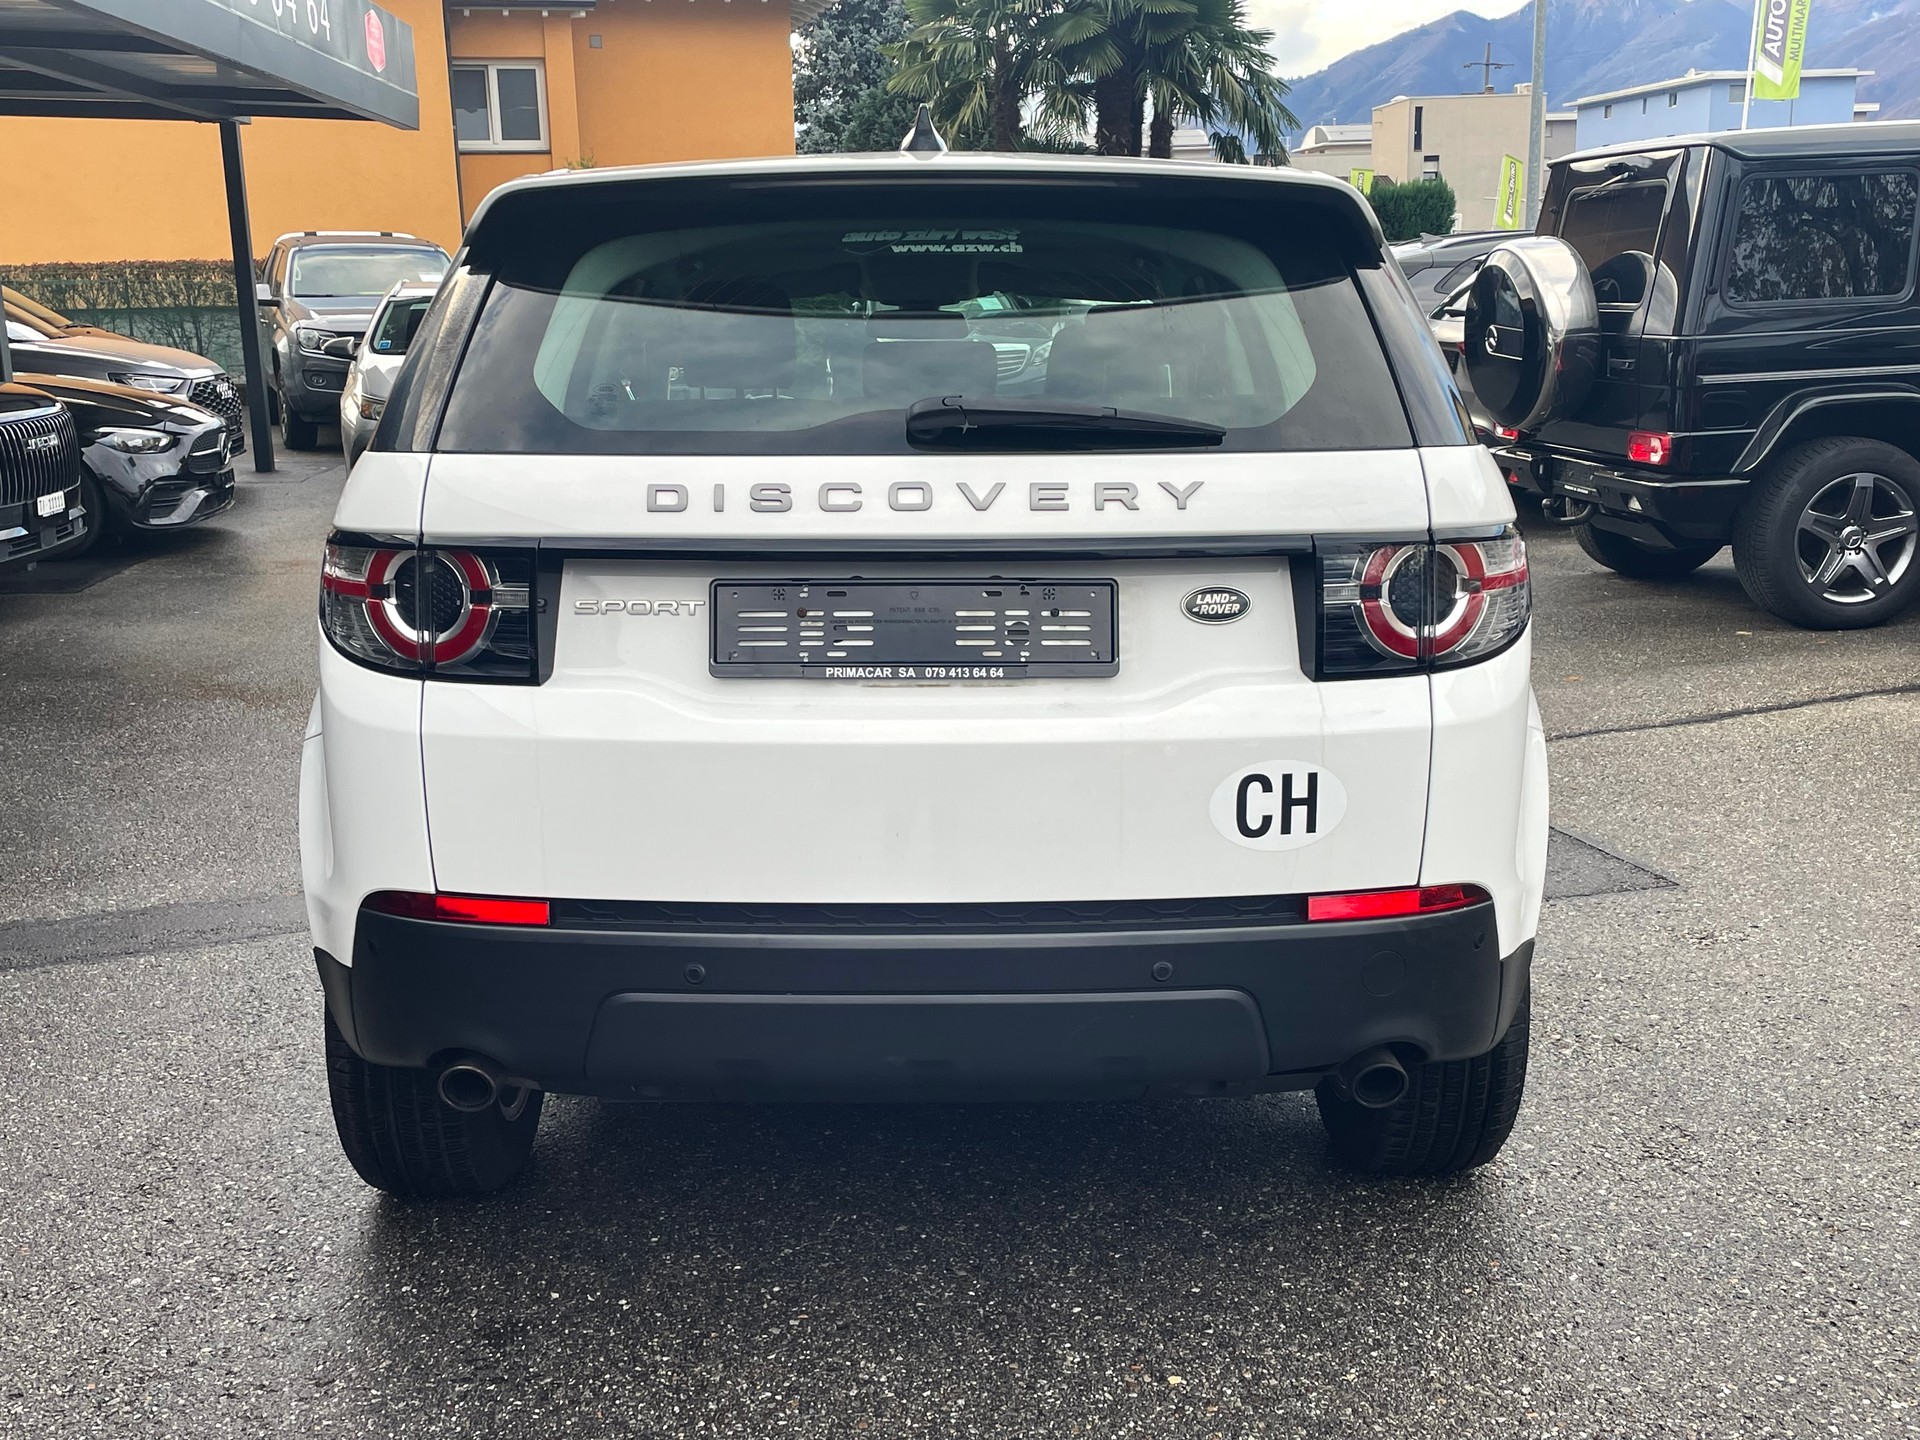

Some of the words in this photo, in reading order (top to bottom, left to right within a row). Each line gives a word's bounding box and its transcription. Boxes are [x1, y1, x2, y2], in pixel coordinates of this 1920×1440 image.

[1764, 0, 1787, 58] AUTO
[890, 242, 1023, 253] www.azw.ch
[646, 481, 1205, 513] DISCOVERY
[1196, 593, 1230, 604] LAND
[574, 599, 706, 617] SPORT
[1199, 603, 1241, 615] ROVER
[825, 667, 892, 678] PRIMACAR
[898, 667, 916, 678] SA
[924, 667, 946, 678] 079
[949, 667, 970, 678] 413
[972, 667, 987, 678] 64
[989, 667, 1004, 678] 64
[1236, 772, 1319, 839] CH
